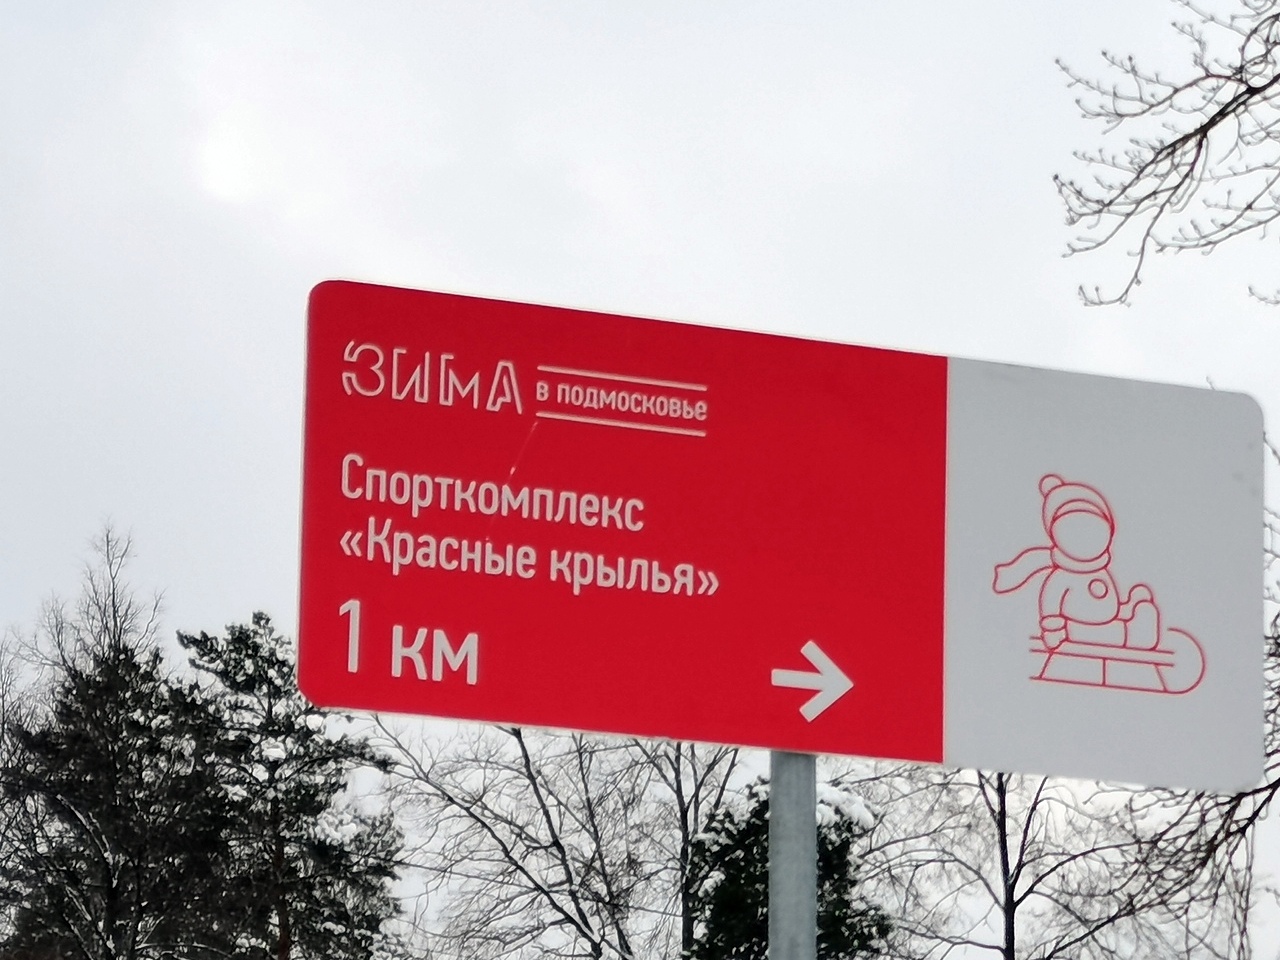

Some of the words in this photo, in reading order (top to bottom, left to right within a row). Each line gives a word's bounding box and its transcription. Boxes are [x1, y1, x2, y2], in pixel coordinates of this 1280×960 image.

[341, 340, 524, 415] ЗИМА
[341, 453, 645, 532] Спорткомплекс
[339, 515, 537, 579] «Красные
[549, 549, 720, 597] крылья»
[339, 598, 361, 674] 1
[391, 624, 479, 686] км
